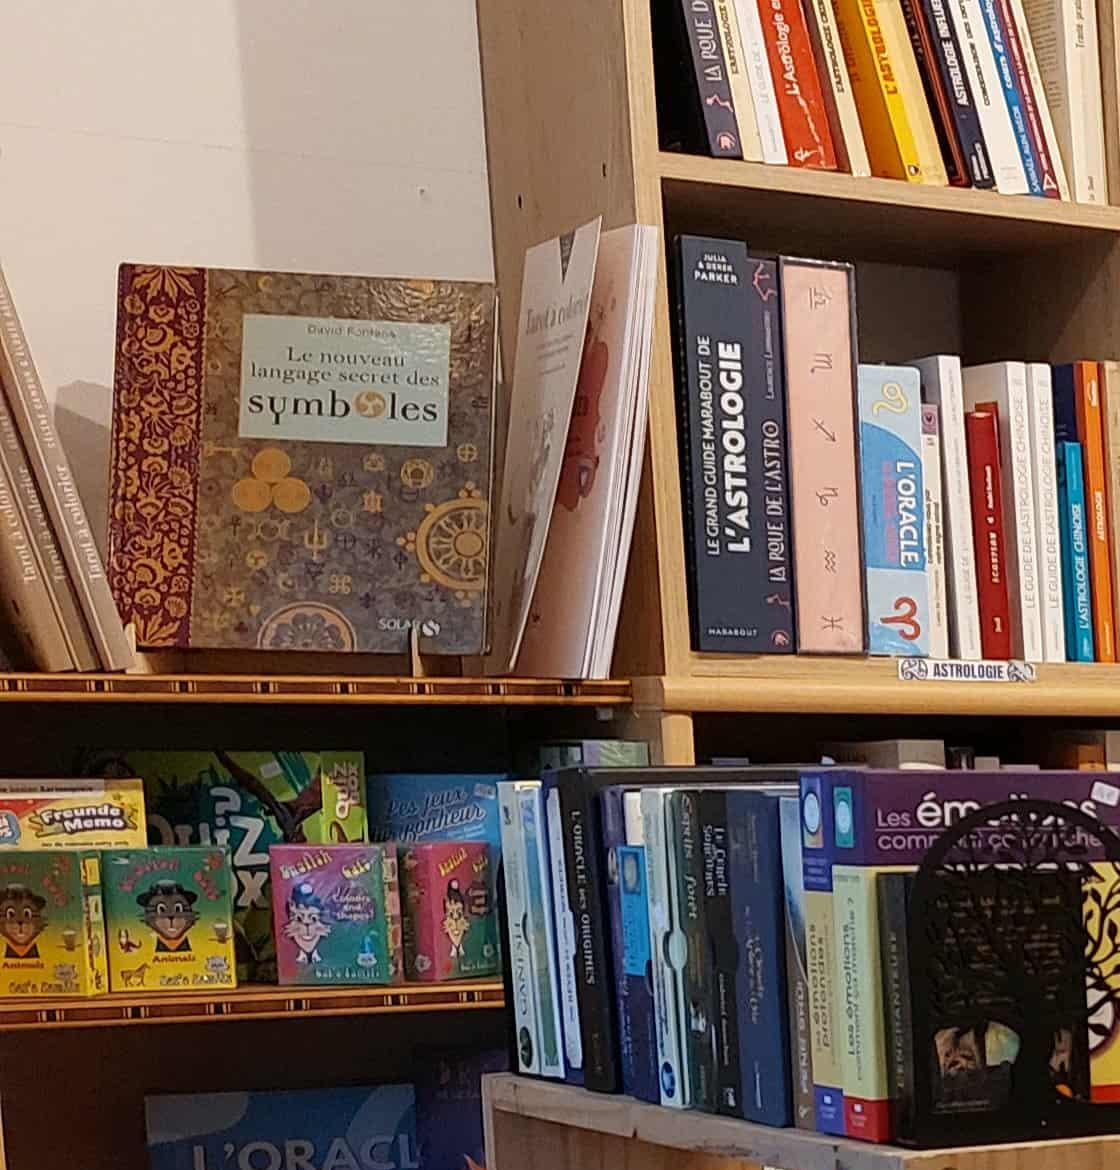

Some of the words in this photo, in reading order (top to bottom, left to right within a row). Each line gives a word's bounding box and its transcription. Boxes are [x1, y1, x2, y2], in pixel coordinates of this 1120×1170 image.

[694, 270, 738, 285] PARKER
[287, 346, 310, 361] Le
[319, 350, 405, 368] nouveau
[697, 335, 711, 356] DE
[250, 362, 333, 384] langage
[338, 367, 401, 385] secret
[405, 370, 440, 387] des
[699, 361, 715, 440] MARABOUT
[718, 342, 751, 553] L'ASTROLOGIE
[761, 420, 782, 492] L'ASTRO
[703, 442, 717, 485] GUIDE
[704, 487, 719, 537] GRAND
[765, 495, 783, 516] DE
[896, 461, 919, 567] L'ORACLE
[1095, 491, 1105, 541] ASTROLOGIE
[1071, 503, 1084, 552] CHINOISE
[706, 539, 720, 555] LE
[766, 521, 785, 561] ROUE
[769, 567, 786, 582] LA
[1074, 555, 1089, 629] L'ASTROLOGIE
[933, 663, 1004, 679] ASTROLOGIE
[41, 805, 121, 822] Freunde
[64, 819, 124, 831] Memo
[876, 807, 911, 828] Les
[152, 954, 196, 963] Animals
